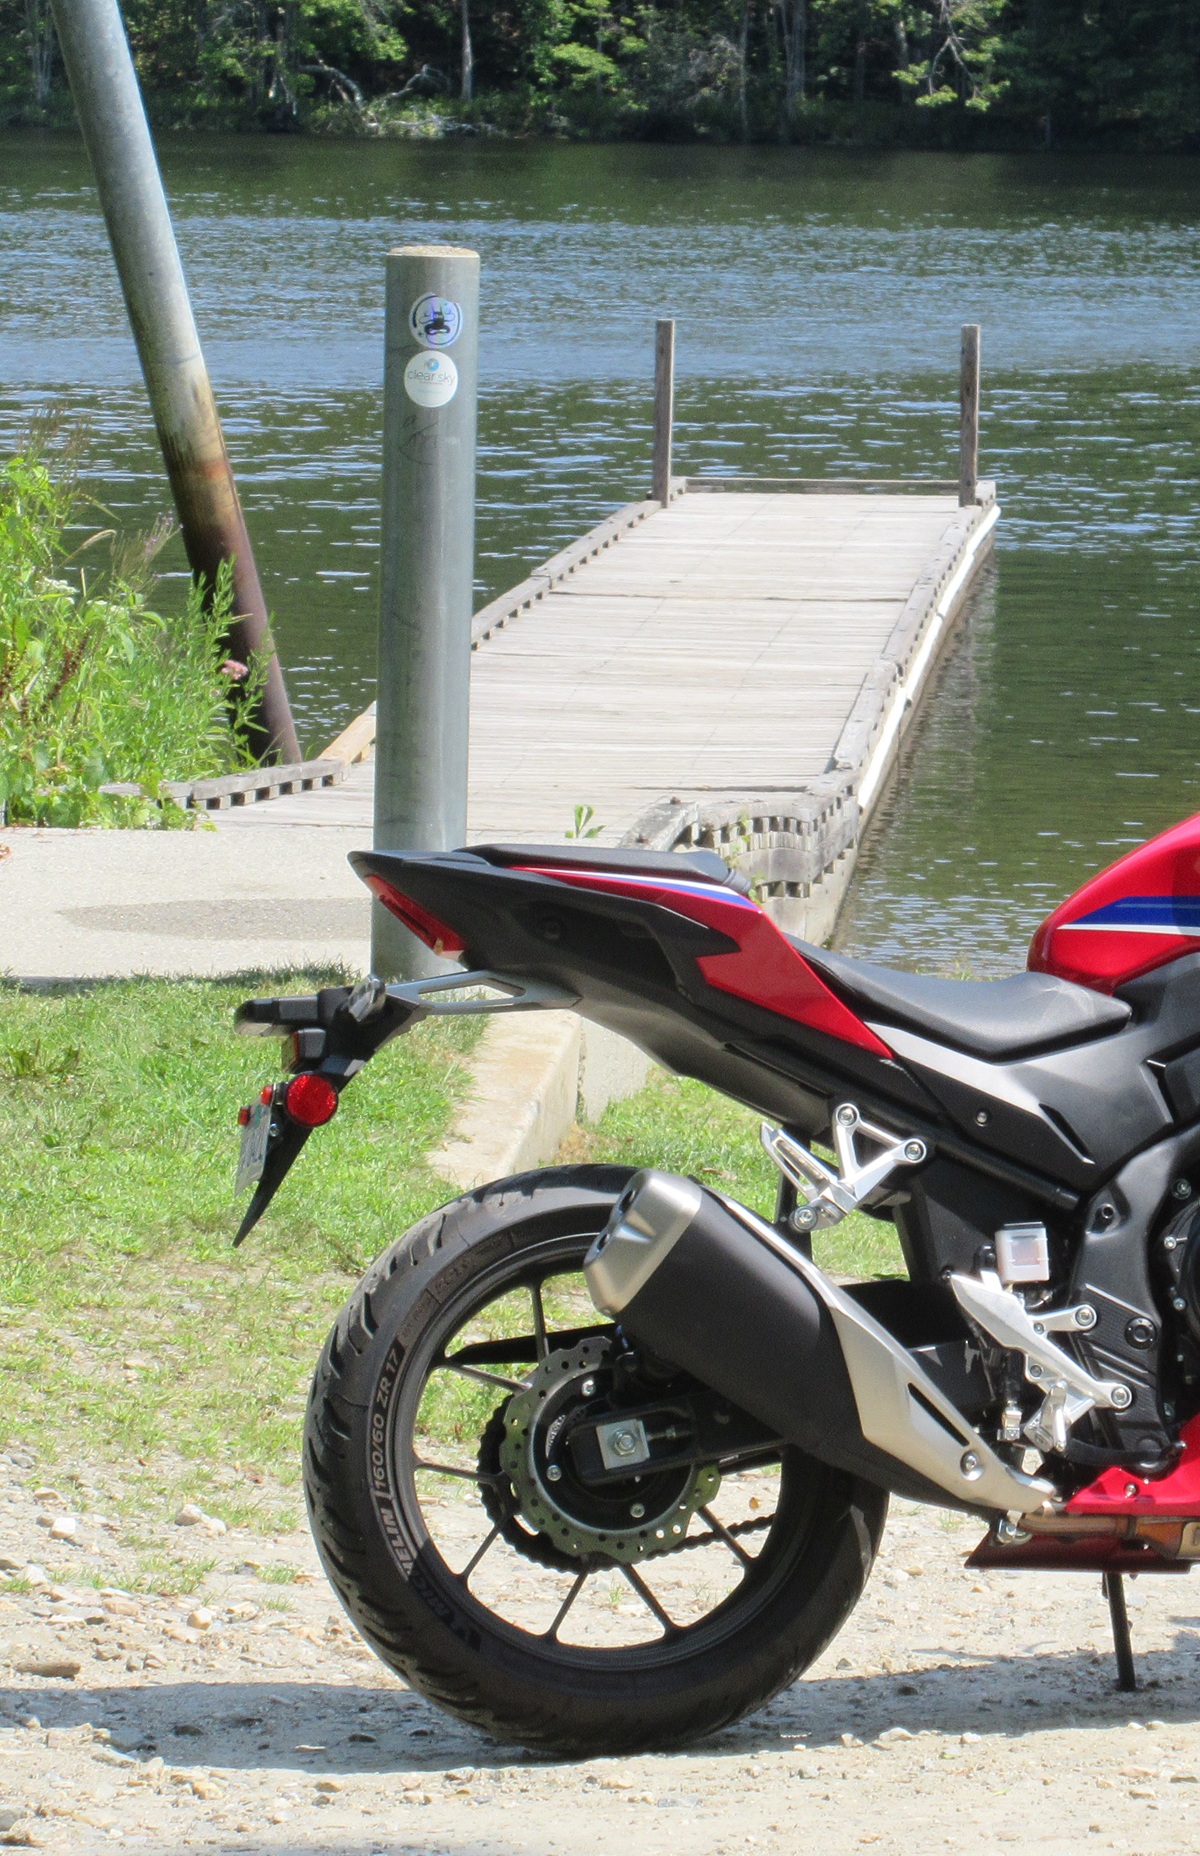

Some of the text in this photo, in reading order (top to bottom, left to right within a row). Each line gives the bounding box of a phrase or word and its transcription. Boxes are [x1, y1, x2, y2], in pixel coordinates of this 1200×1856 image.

[407, 370, 456, 385] clear sky
[385, 1345, 402, 1373] 17
[375, 1378, 392, 1410] ZR
[370, 1413, 387, 1490] 160/60
